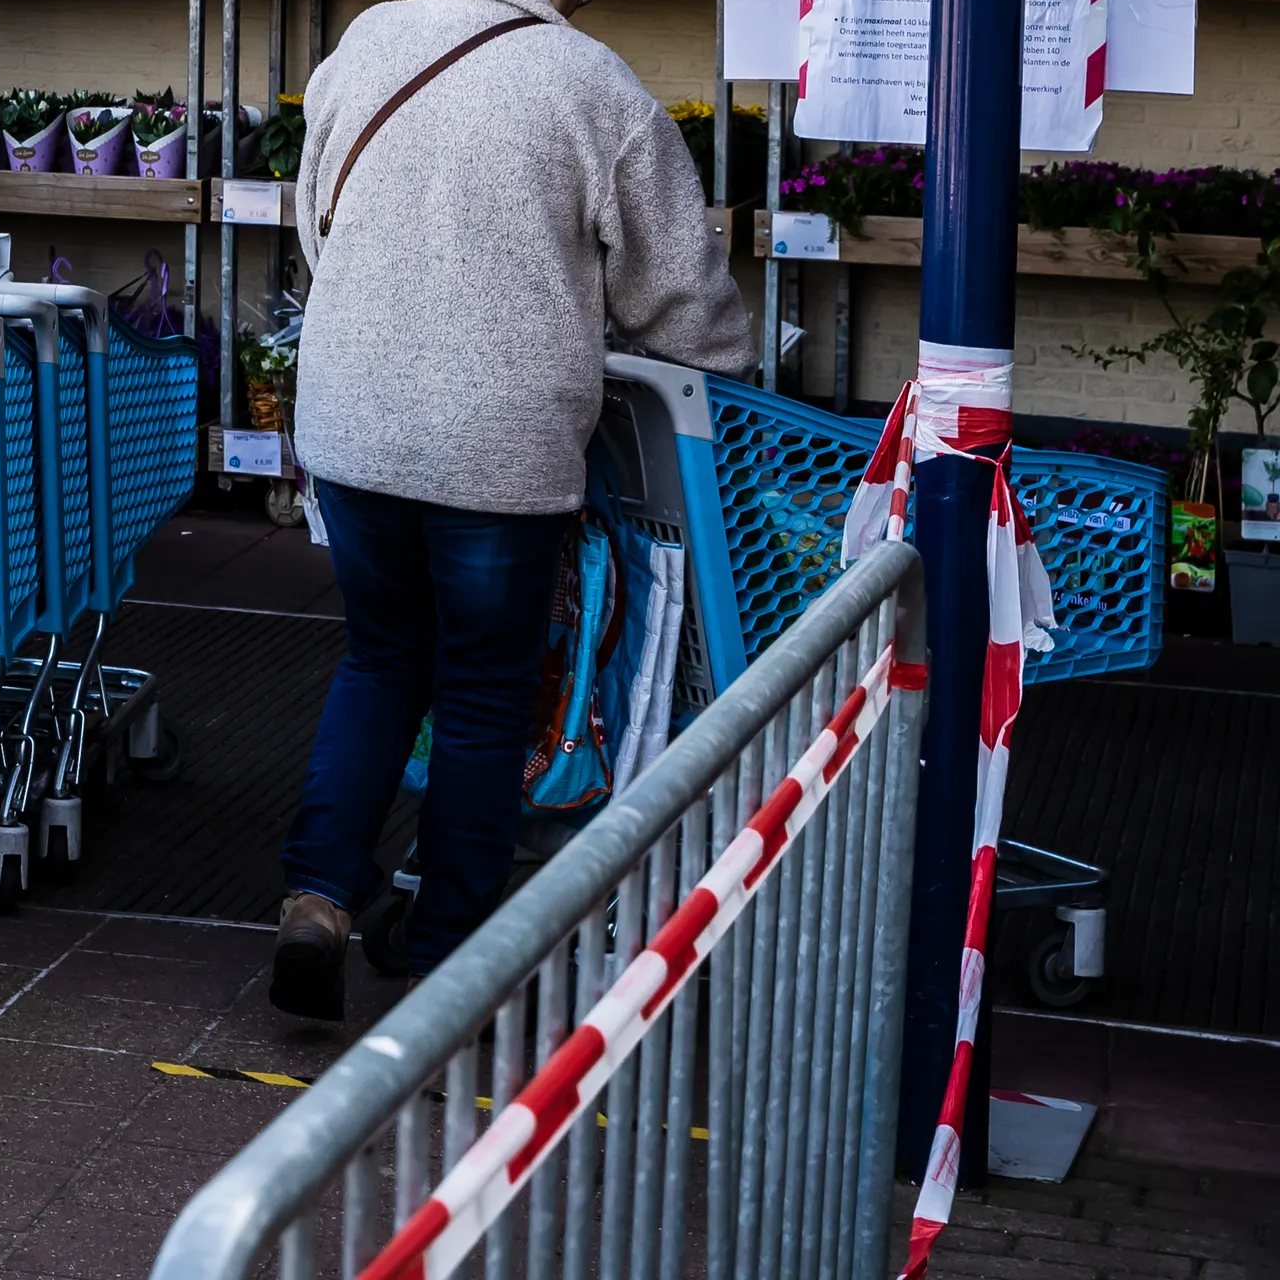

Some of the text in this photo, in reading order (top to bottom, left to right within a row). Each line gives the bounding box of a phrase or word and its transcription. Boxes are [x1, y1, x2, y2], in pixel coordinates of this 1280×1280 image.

[850, 17, 863, 25] zijn
[864, 17, 902, 25] maximaal
[886, 29, 905, 37] heeft
[887, 41, 926, 50] toegestaan
[838, 51, 890, 60] winkelwagens
[1060, 59, 1071, 67] de
[862, 77, 902, 86] handhaven
[903, 80, 915, 88] wij
[916, 80, 926, 89] bij
[910, 94, 923, 102] We
[903, 108, 927, 116] Albert
